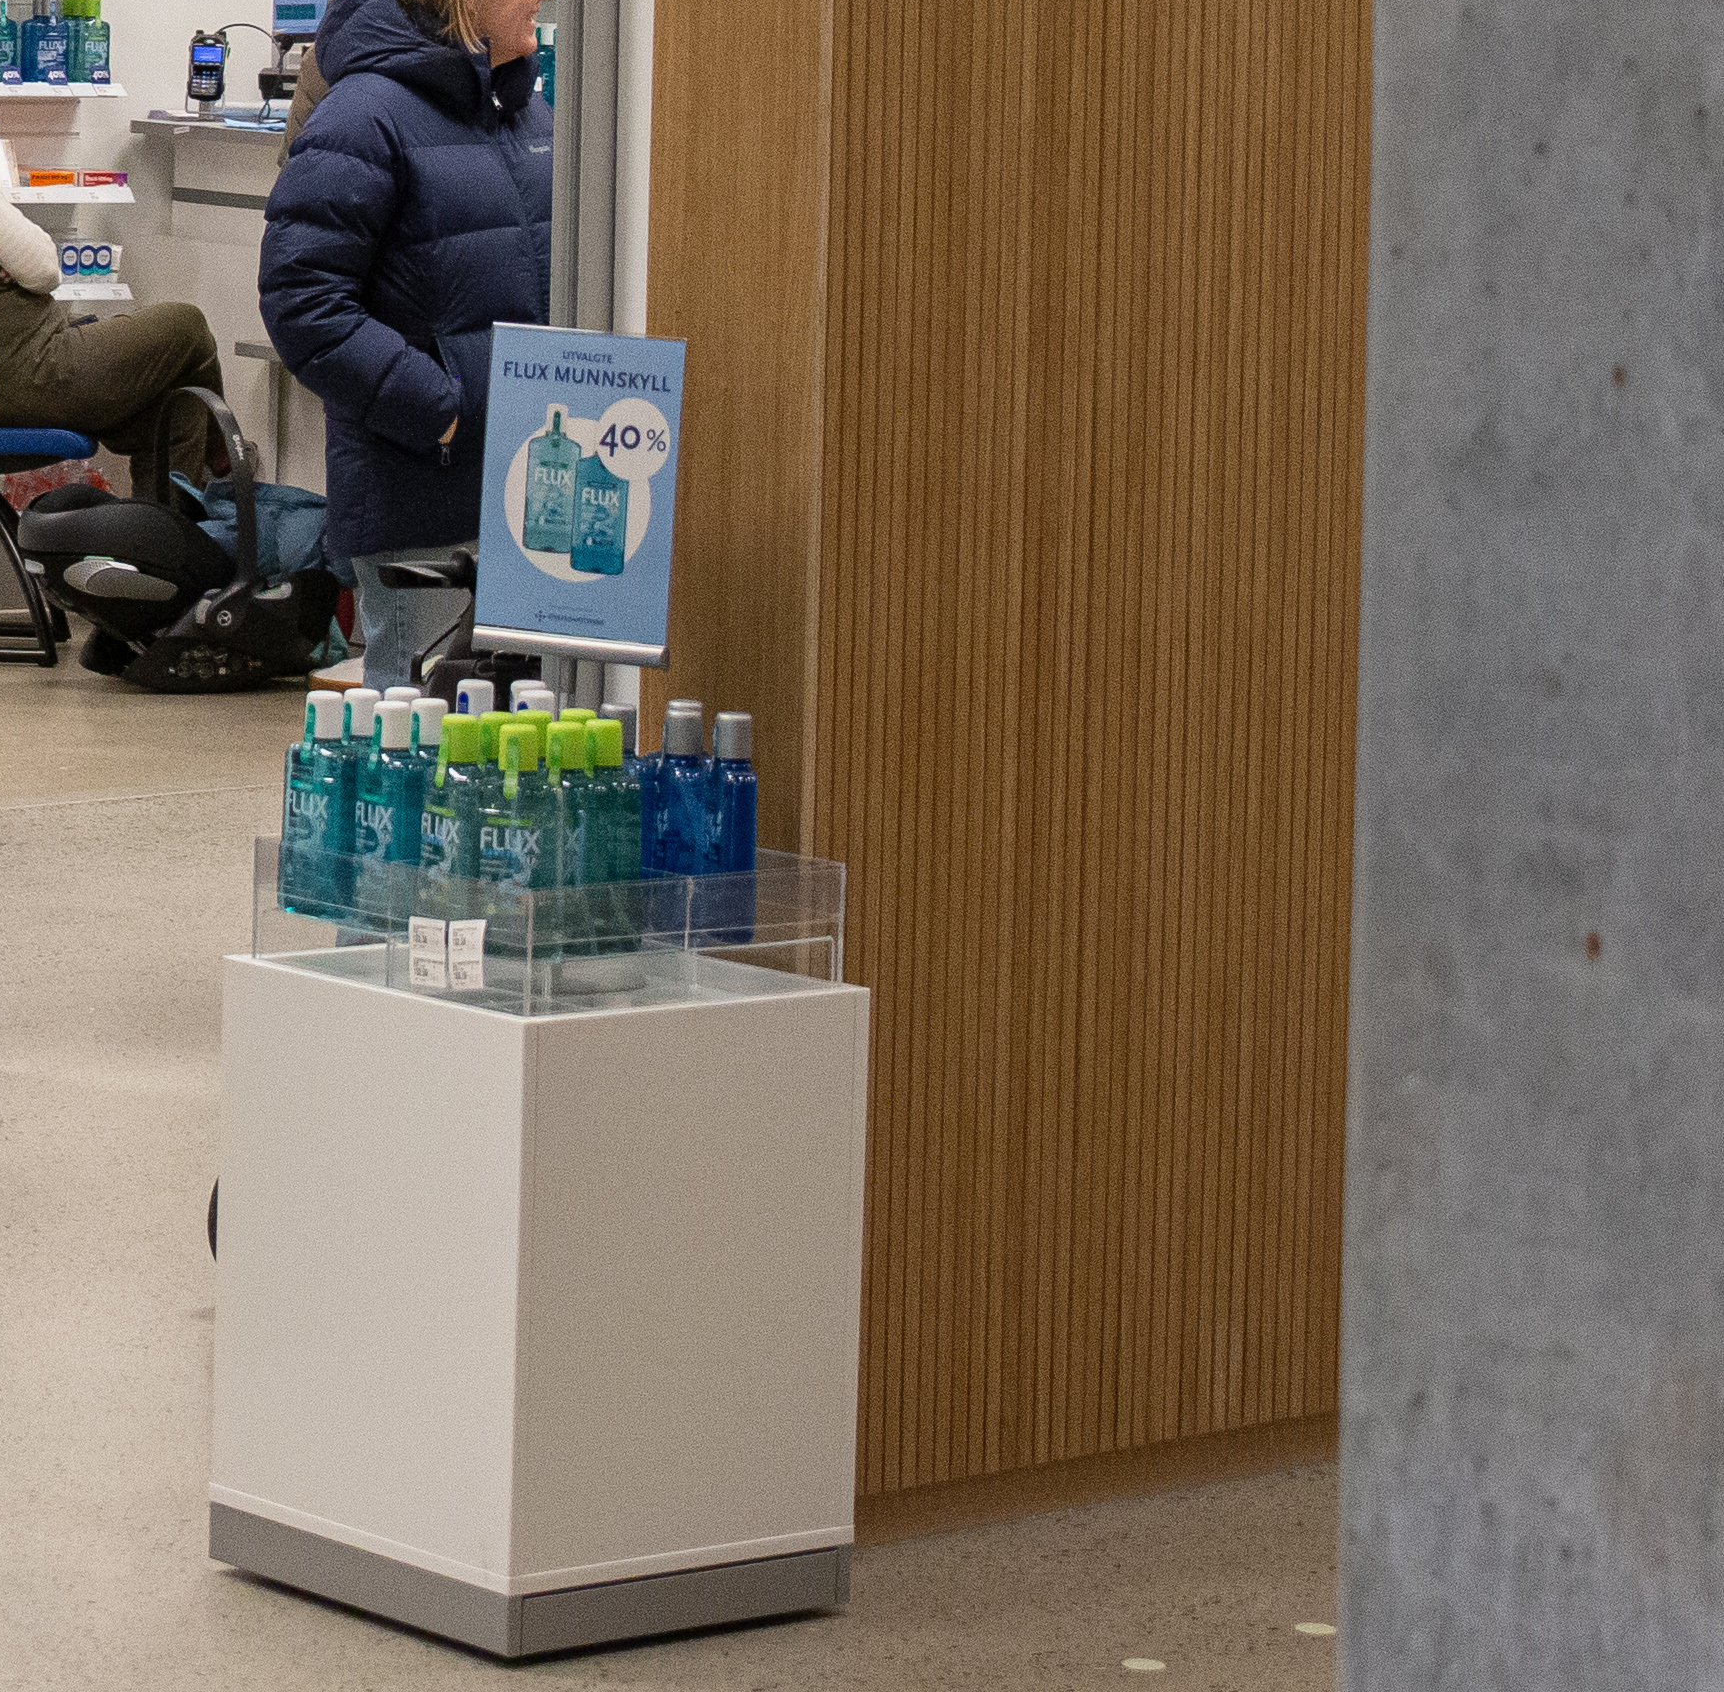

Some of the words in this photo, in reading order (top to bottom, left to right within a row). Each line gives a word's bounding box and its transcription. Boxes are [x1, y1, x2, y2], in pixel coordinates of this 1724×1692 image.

[503, 361, 548, 381] FLUX
[554, 369, 671, 393] MUNNSKYLL
[534, 467, 572, 485] FLUX
[581, 487, 619, 507] FLUX
[355, 800, 394, 832] FLUX
[420, 810, 460, 845] FLUX
[480, 826, 541, 854] FLUX
